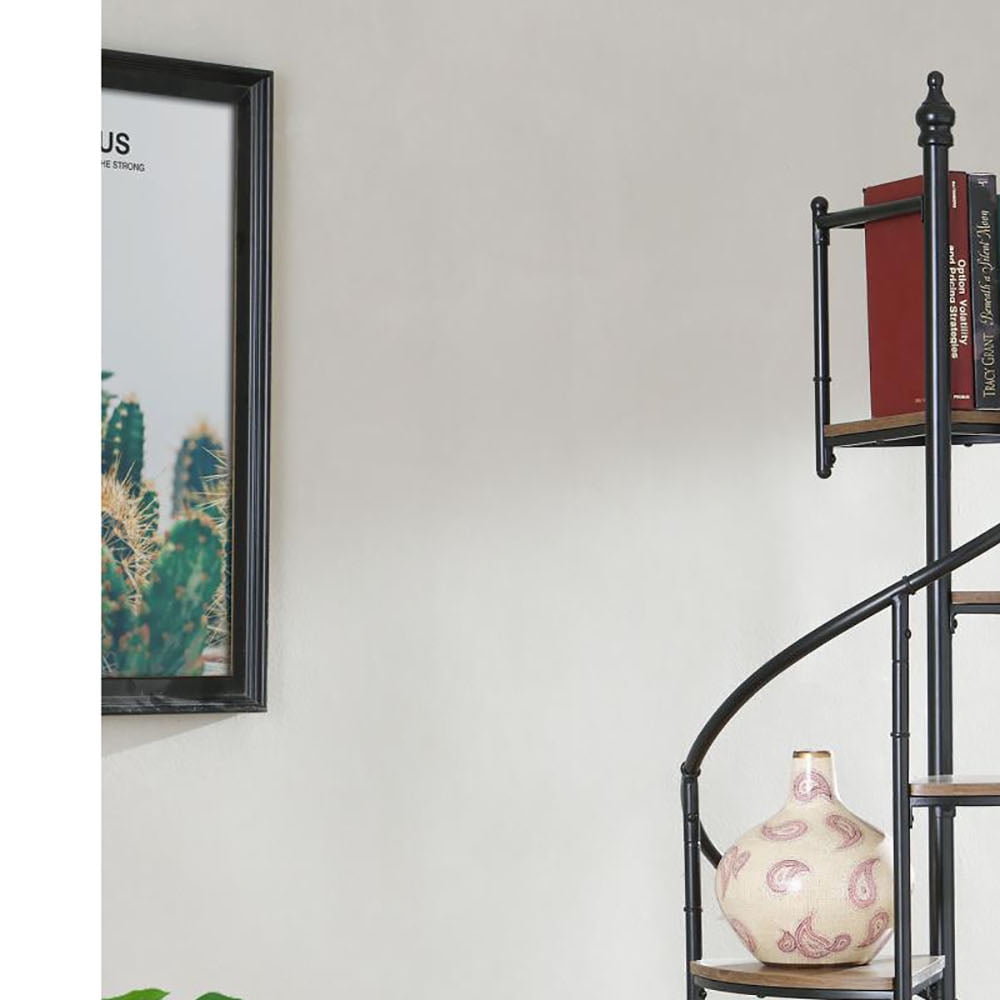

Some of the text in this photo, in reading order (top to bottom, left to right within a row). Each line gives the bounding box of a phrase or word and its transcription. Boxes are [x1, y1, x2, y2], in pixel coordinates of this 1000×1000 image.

[112, 160, 145, 172] STRONG
[976, 210, 992, 239] Moon
[977, 240, 995, 274] Silent
[949, 267, 957, 304] Pricing
[957, 259, 969, 346] Option Volatility
[978, 281, 995, 326] Beneath
[949, 306, 960, 359] Strategies
[981, 332, 997, 398] TRACY GRANT
